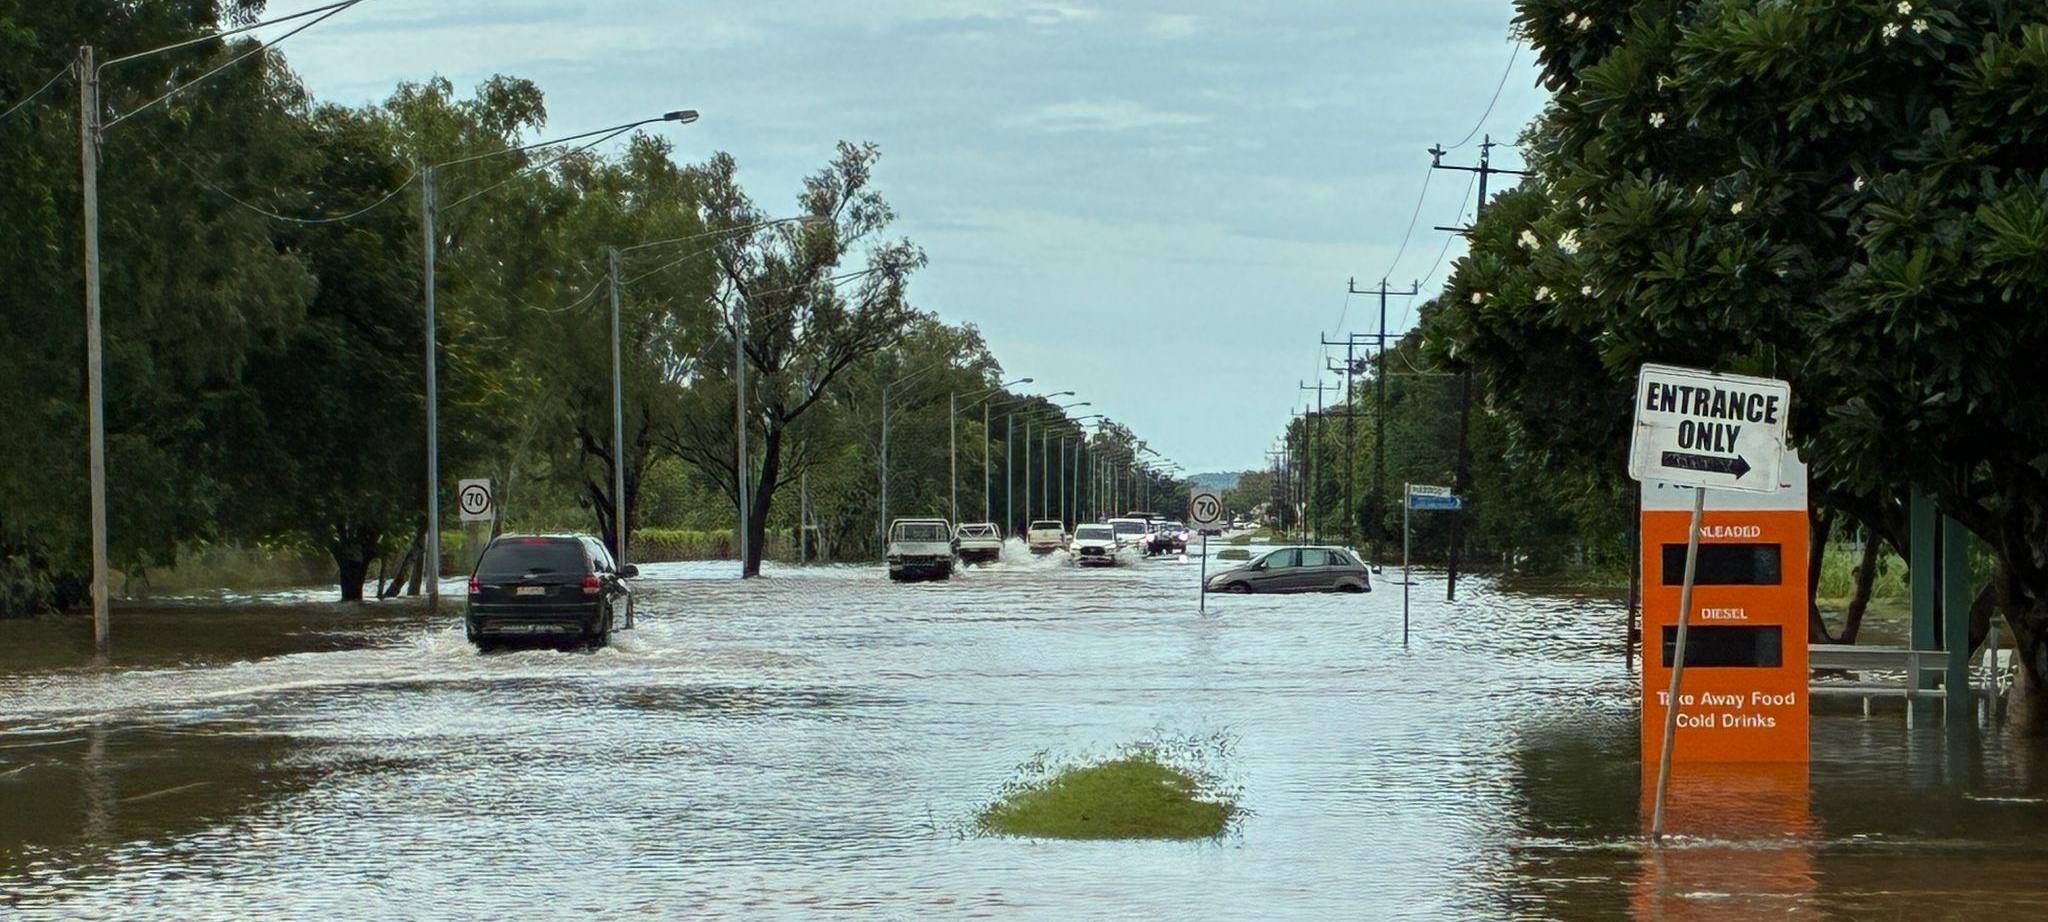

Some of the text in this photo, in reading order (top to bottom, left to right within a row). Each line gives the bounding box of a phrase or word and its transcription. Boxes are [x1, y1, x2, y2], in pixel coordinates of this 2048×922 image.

[1646, 382, 1779, 424] ENTRANCE
[1678, 419, 1741, 453] ONLY
[467, 493, 484, 506] 70
[1197, 501, 1216, 516] 70
[1692, 525, 1760, 537] NLEADED
[1701, 608, 1748, 619] DIESEL
[1656, 691, 1795, 709] Tke Away Food
[1676, 713, 1776, 728] Cold Drinks
